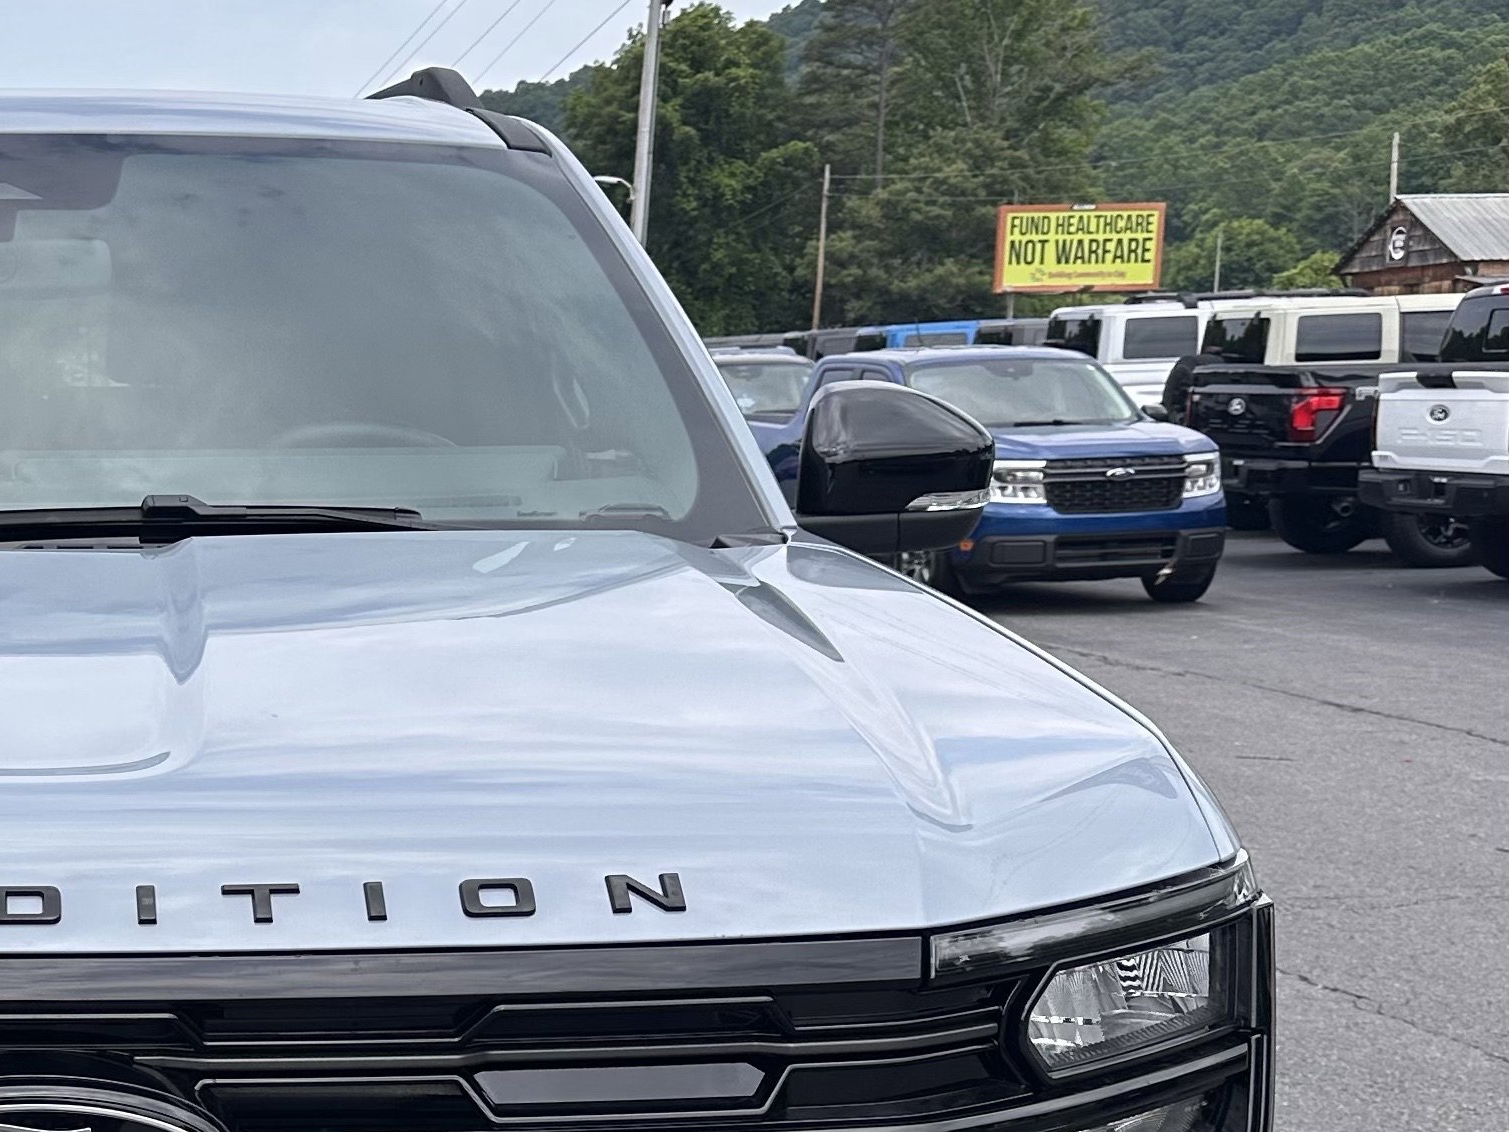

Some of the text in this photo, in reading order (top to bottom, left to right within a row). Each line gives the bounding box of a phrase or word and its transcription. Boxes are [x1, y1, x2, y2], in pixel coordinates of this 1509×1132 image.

[1009, 214, 1155, 236] FUND HEALTHCARE
[1008, 237, 1154, 265] NOT WARFARE
